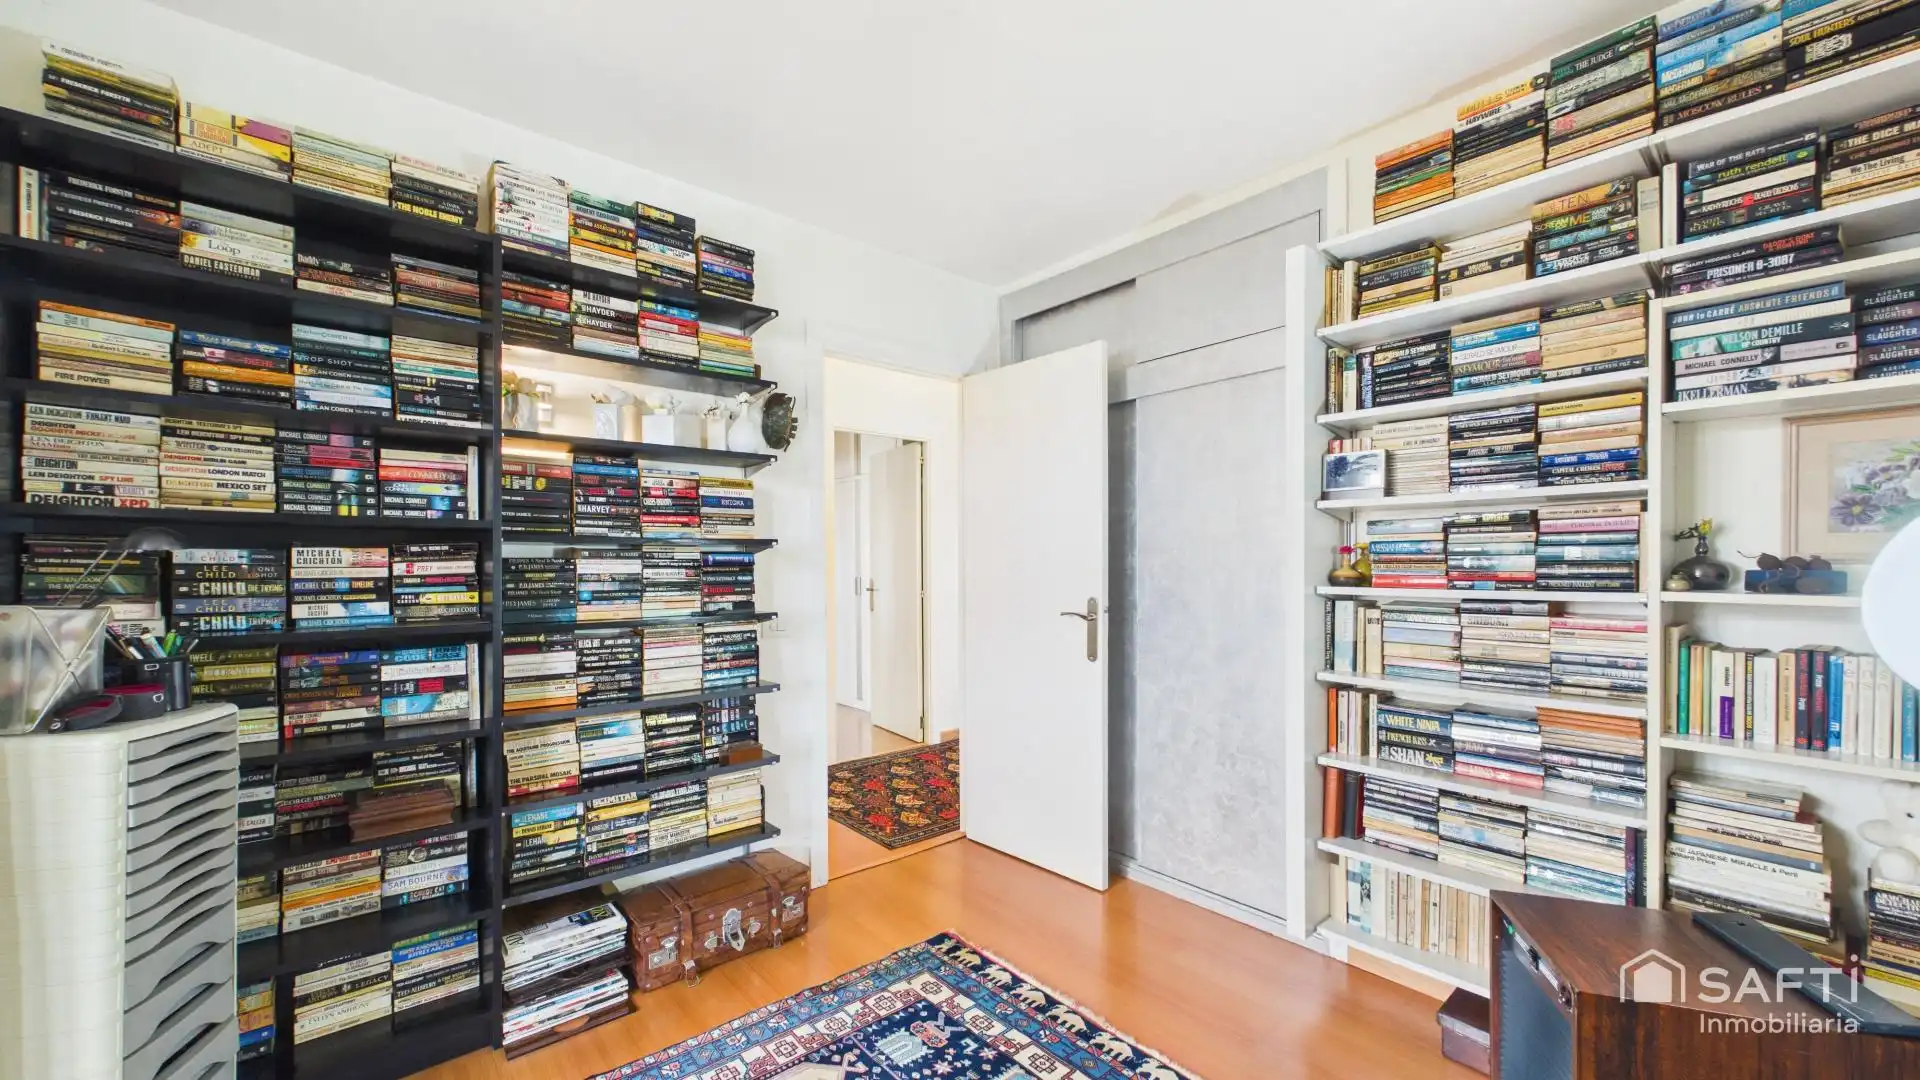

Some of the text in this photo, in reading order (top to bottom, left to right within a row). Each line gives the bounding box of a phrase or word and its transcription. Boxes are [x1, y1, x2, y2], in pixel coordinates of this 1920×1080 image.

[1789, 35, 1813, 47] SOUL
[1814, 16, 1856, 39] HUNTERS
[1575, 49, 1615, 70] THE JUDGE
[1465, 106, 1502, 126] HAYWIRE
[1848, 126, 1900, 147] THE DICE
[1728, 154, 1744, 163] THE
[1745, 147, 1766, 158] RATS
[1864, 161, 1878, 169] The
[1880, 155, 1905, 168] Living
[1718, 153, 1786, 179] ruth rendell
[412, 206, 438, 217] NOBLE
[1569, 211, 1591, 225] ME
[184, 254, 262, 278] DANIEL EASTERMAN
[1706, 261, 1755, 281] PRISONER
[1672, 287, 1830, 324] JOHN CARRÉ ABSOLUTE FRIENDS
[1864, 291, 1916, 306] SLAUGHTER
[586, 305, 616, 318] HAYDER
[1863, 309, 1914, 322] SLAUGHTER
[586, 317, 613, 330] HAYDER
[1762, 323, 1804, 339] DEMILLE
[1866, 328, 1918, 341] SLAUGHTER
[1868, 348, 1920, 361] SLAUGHTER
[1684, 354, 1760, 371] MICHAEL CONNELLY
[54, 372, 111, 386] FIRE POWER
[31, 420, 77, 429] DEIGHTON
[279, 431, 329, 441] MICHAEL CONNELLY
[34, 457, 79, 470] DEIGHTON
[28, 471, 46, 479] LEN
[47, 473, 96, 481] DEIGHTON
[208, 468, 241, 477] LONDON
[217, 482, 251, 491] MEXICO
[282, 481, 332, 490] MICHAEL CONNELLY
[31, 493, 150, 509] DEIGHTON XPD
[283, 503, 333, 513] MICHAEL CONNELLY
[384, 497, 428, 506] MICHAEL CONNELLY
[582, 505, 610, 514] HARVEY
[297, 557, 343, 566] CRICHTON
[196, 571, 237, 579] CHILD
[416, 565, 434, 573] PREY
[200, 581, 247, 596] CHILD
[294, 581, 320, 590] MICHAEL
[320, 580, 350, 589] CRICHTON
[200, 616, 247, 631] CHILD
[1385, 714, 1441, 732] WHITE NINJA
[1386, 731, 1412, 744] FRENCH
[1389, 746, 1425, 766] SHAN
[1687, 847, 1729, 864] JAPANESE
[1730, 857, 1770, 873] MIRACLE
[1779, 869, 1800, 879] Peril
[1696, 856, 1717, 867] Price
[388, 871, 445, 891] SAM BOURNE
[355, 975, 389, 989] LEGACY
